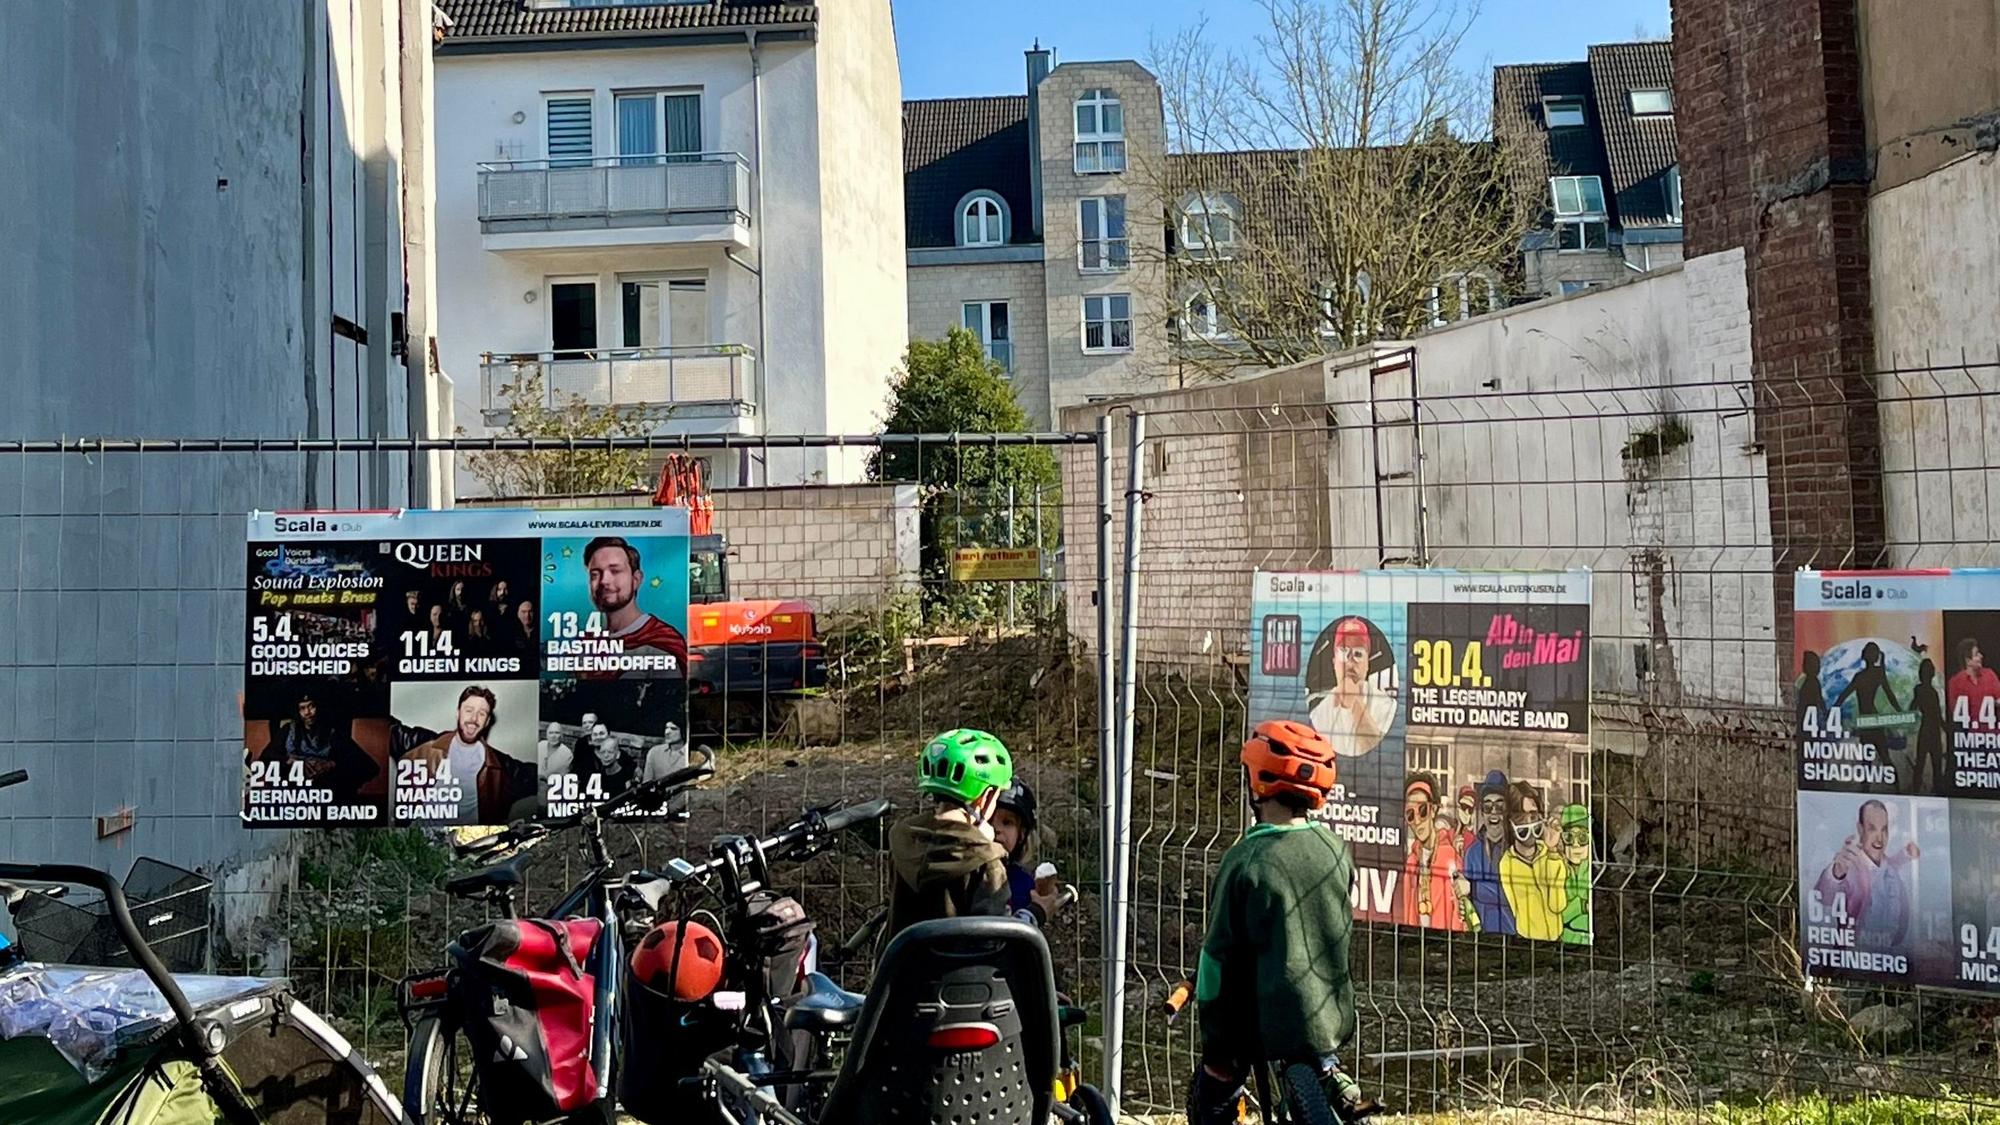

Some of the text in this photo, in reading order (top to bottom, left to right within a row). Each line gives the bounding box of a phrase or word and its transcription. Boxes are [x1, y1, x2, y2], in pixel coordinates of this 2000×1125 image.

[274, 517, 326, 532] Scala
[528, 520, 663, 529] WWW.SCALA-LEVERKUSEN.DE
[256, 548, 311, 557] Good Voices
[395, 542, 482, 569] QUEEN
[431, 562, 492, 577] KINGS
[253, 573, 384, 591] Sound Explosion
[1270, 577, 1305, 592] Scala
[1821, 580, 1908, 599] Scala Club
[260, 591, 376, 607] Pop meets Brass
[253, 615, 299, 642] 5.4.
[548, 611, 609, 638] 13.4.
[1486, 614, 1534, 647] Ab in
[251, 643, 370, 659] GOOD VOICES
[400, 630, 460, 657] 11.4.
[547, 639, 624, 654] BASTIAN
[1503, 630, 1583, 670] den Mai
[251, 657, 351, 675] DÜRSCHEID
[399, 657, 520, 673] QUEEN KINGS
[547, 655, 677, 671] BIELENDORFER
[1413, 640, 1492, 687] 30.4.
[1412, 688, 1527, 708] THE LEGENDARY
[1412, 708, 1569, 729] GHETTO DANCE BAND
[1803, 706, 1849, 738] 4.4.
[1954, 732, 2000, 749] IMPR
[1804, 742, 1876, 761] MOVING
[250, 760, 312, 787] 24.4.
[397, 759, 459, 786] 25.4.
[1804, 763, 1896, 784] SHADOWS
[396, 787, 462, 802] MARCO
[547, 773, 610, 800] 26.4.
[249, 789, 333, 804] BERNARD
[249, 805, 378, 821] ALLISON BAND
[395, 804, 459, 819] GIANNI
[1335, 825, 1400, 846] FIRDOUSI
[1808, 890, 1855, 927] 6.4.
[1807, 924, 1856, 947] RENÉ
[1808, 947, 1908, 973] STEINBERG
[1961, 962, 2000, 983] MIC
